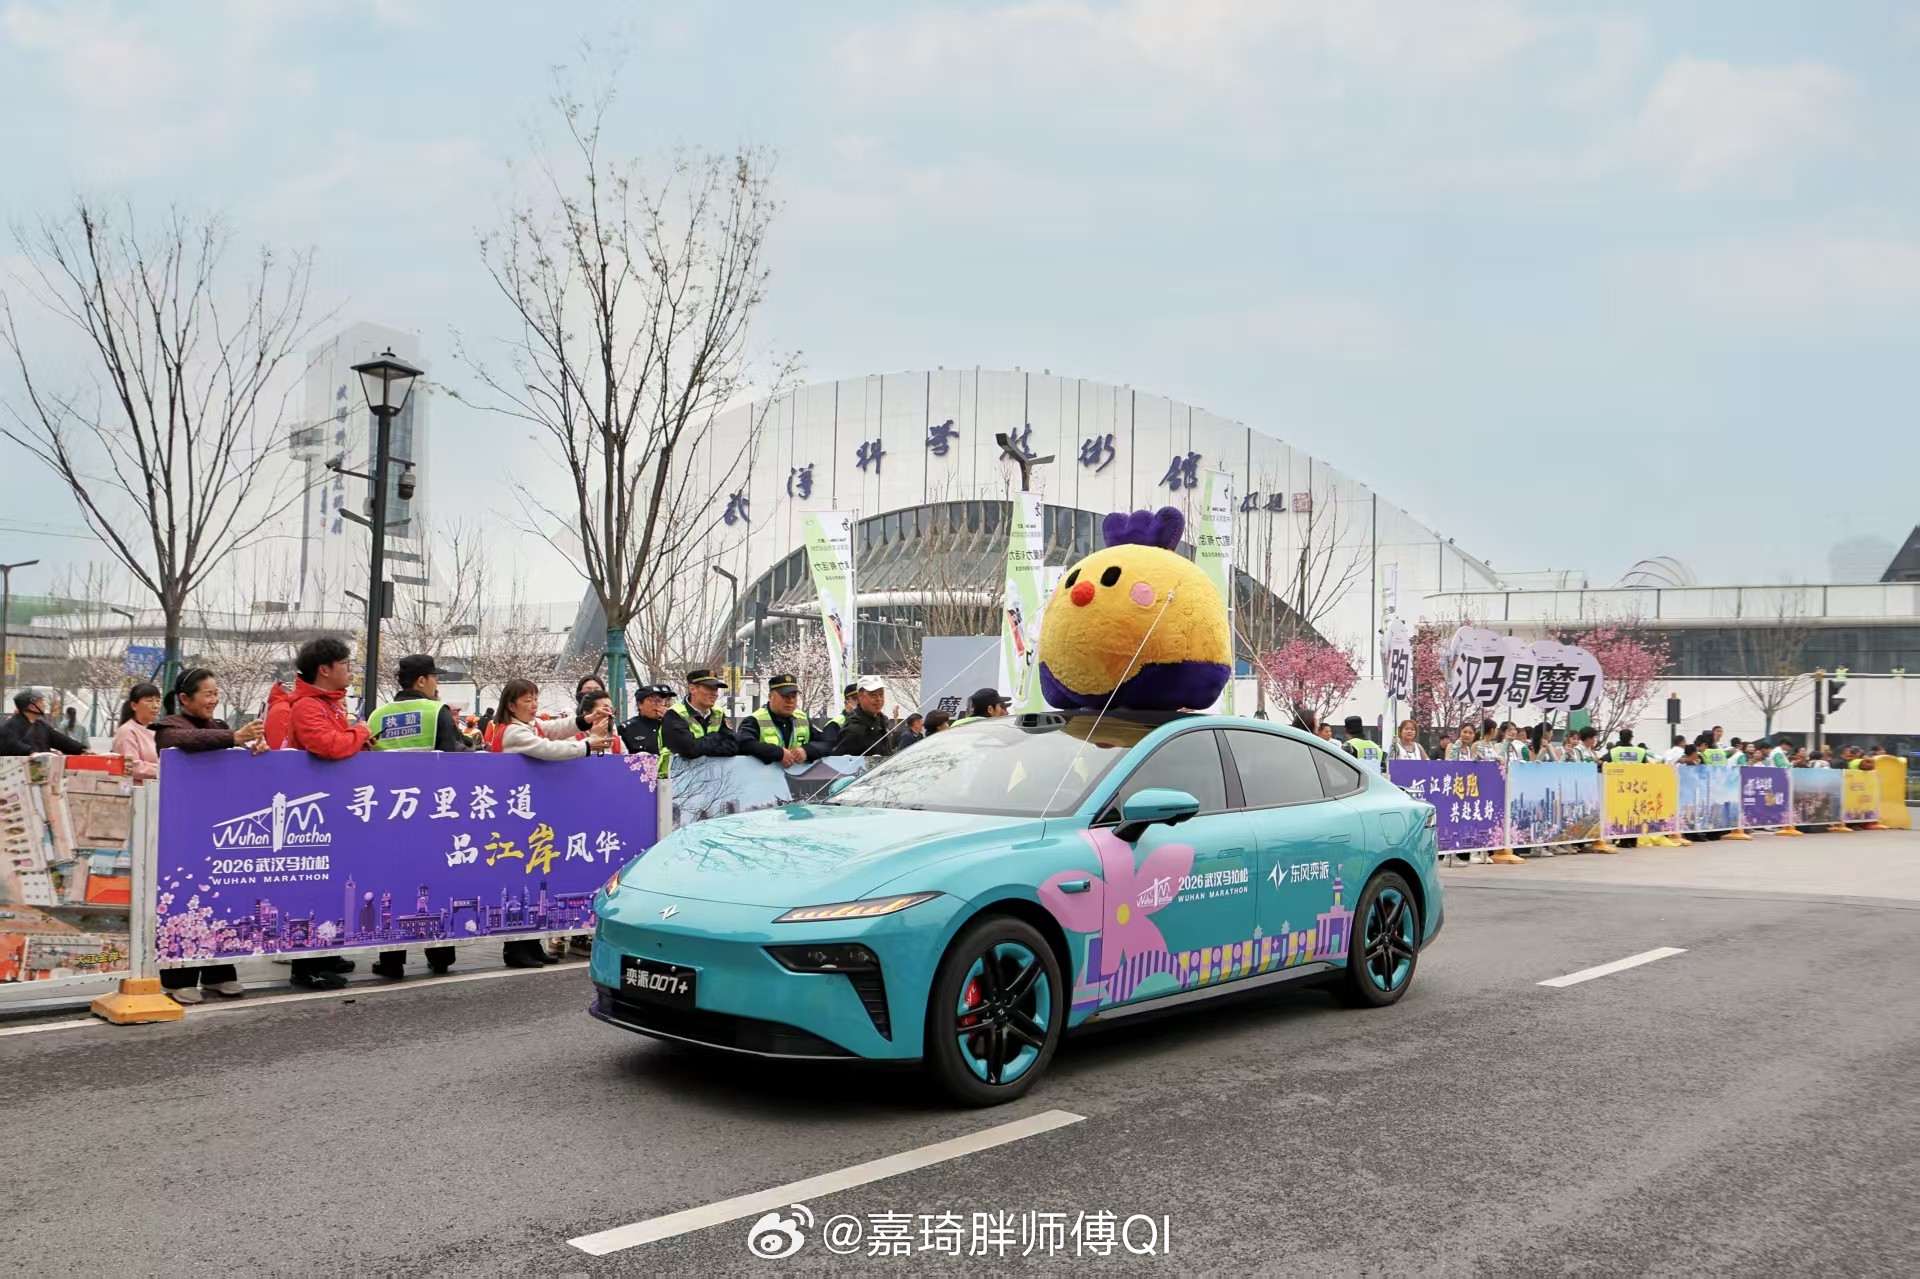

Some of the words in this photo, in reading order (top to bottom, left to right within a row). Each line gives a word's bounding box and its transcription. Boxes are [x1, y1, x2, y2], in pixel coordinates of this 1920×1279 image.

[385, 712, 417, 728] 执勤
[385, 729, 400, 738] ZHI
[402, 727, 417, 736] QIN
[346, 784, 537, 823] 寻万里茶道
[212, 820, 271, 848] Wuhan
[445, 823, 622, 875] 品江岸风华
[212, 877, 257, 885] WUHAN
[263, 873, 330, 883] MARATHON
[1290, 861, 1330, 884] 东风奕派
[1178, 893, 1205, 903] WUHAN
[1209, 886, 1249, 898] MARATHON
